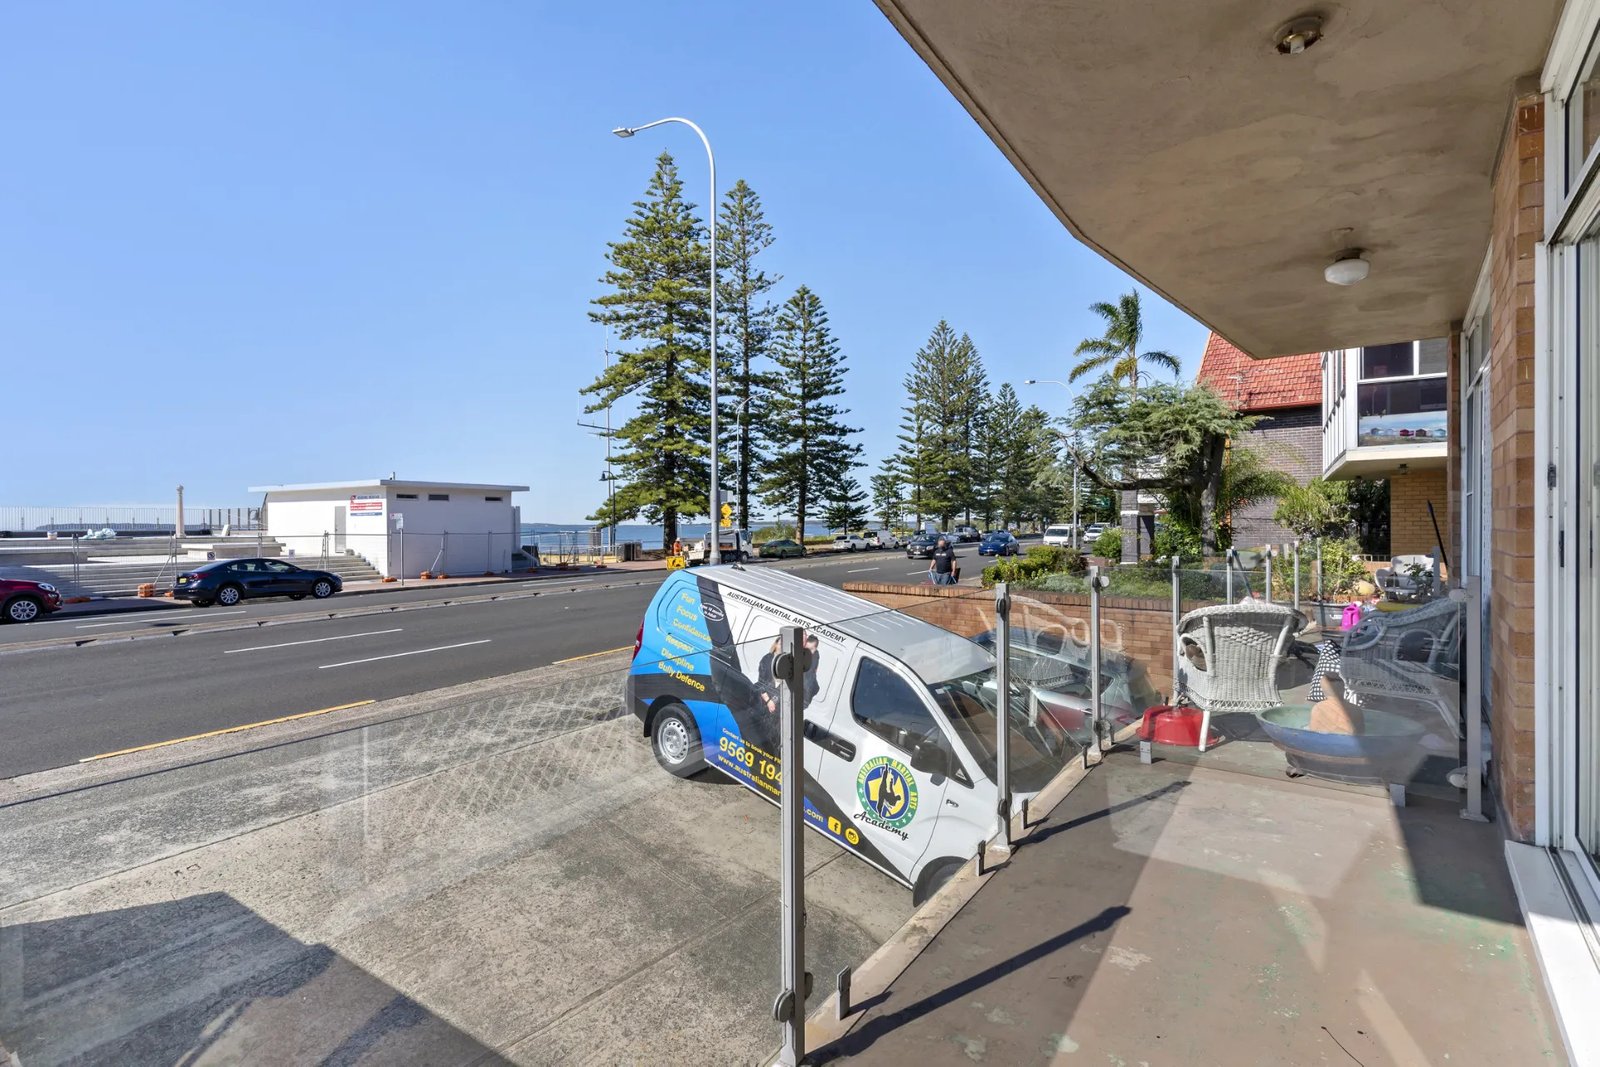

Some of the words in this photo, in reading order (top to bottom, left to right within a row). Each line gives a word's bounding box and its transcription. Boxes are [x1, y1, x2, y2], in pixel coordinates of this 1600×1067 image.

[681, 592, 696, 604] Fun
[676, 605, 698, 622] Focus
[727, 591, 765, 610] AUSTRALIAN
[764, 606, 791, 621] MARTIAL
[792, 617, 811, 630] ARTS
[811, 625, 847, 643] ACADEMY
[665, 634, 695, 653] Respect
[672, 618, 712, 642] Confidence
[661, 647, 695, 671] Discipline
[658, 661, 676, 677] Bully
[675, 671, 705, 692] Defence
[719, 736, 754, 767] 9569
[759, 759, 782, 785] 194
[718, 755, 782, 796] www.australianmar
[804, 806, 824, 822] .com
[891, 759, 914, 786] MARTIAL
[909, 791, 918, 810] ARTS
[853, 811, 909, 841] Academy
